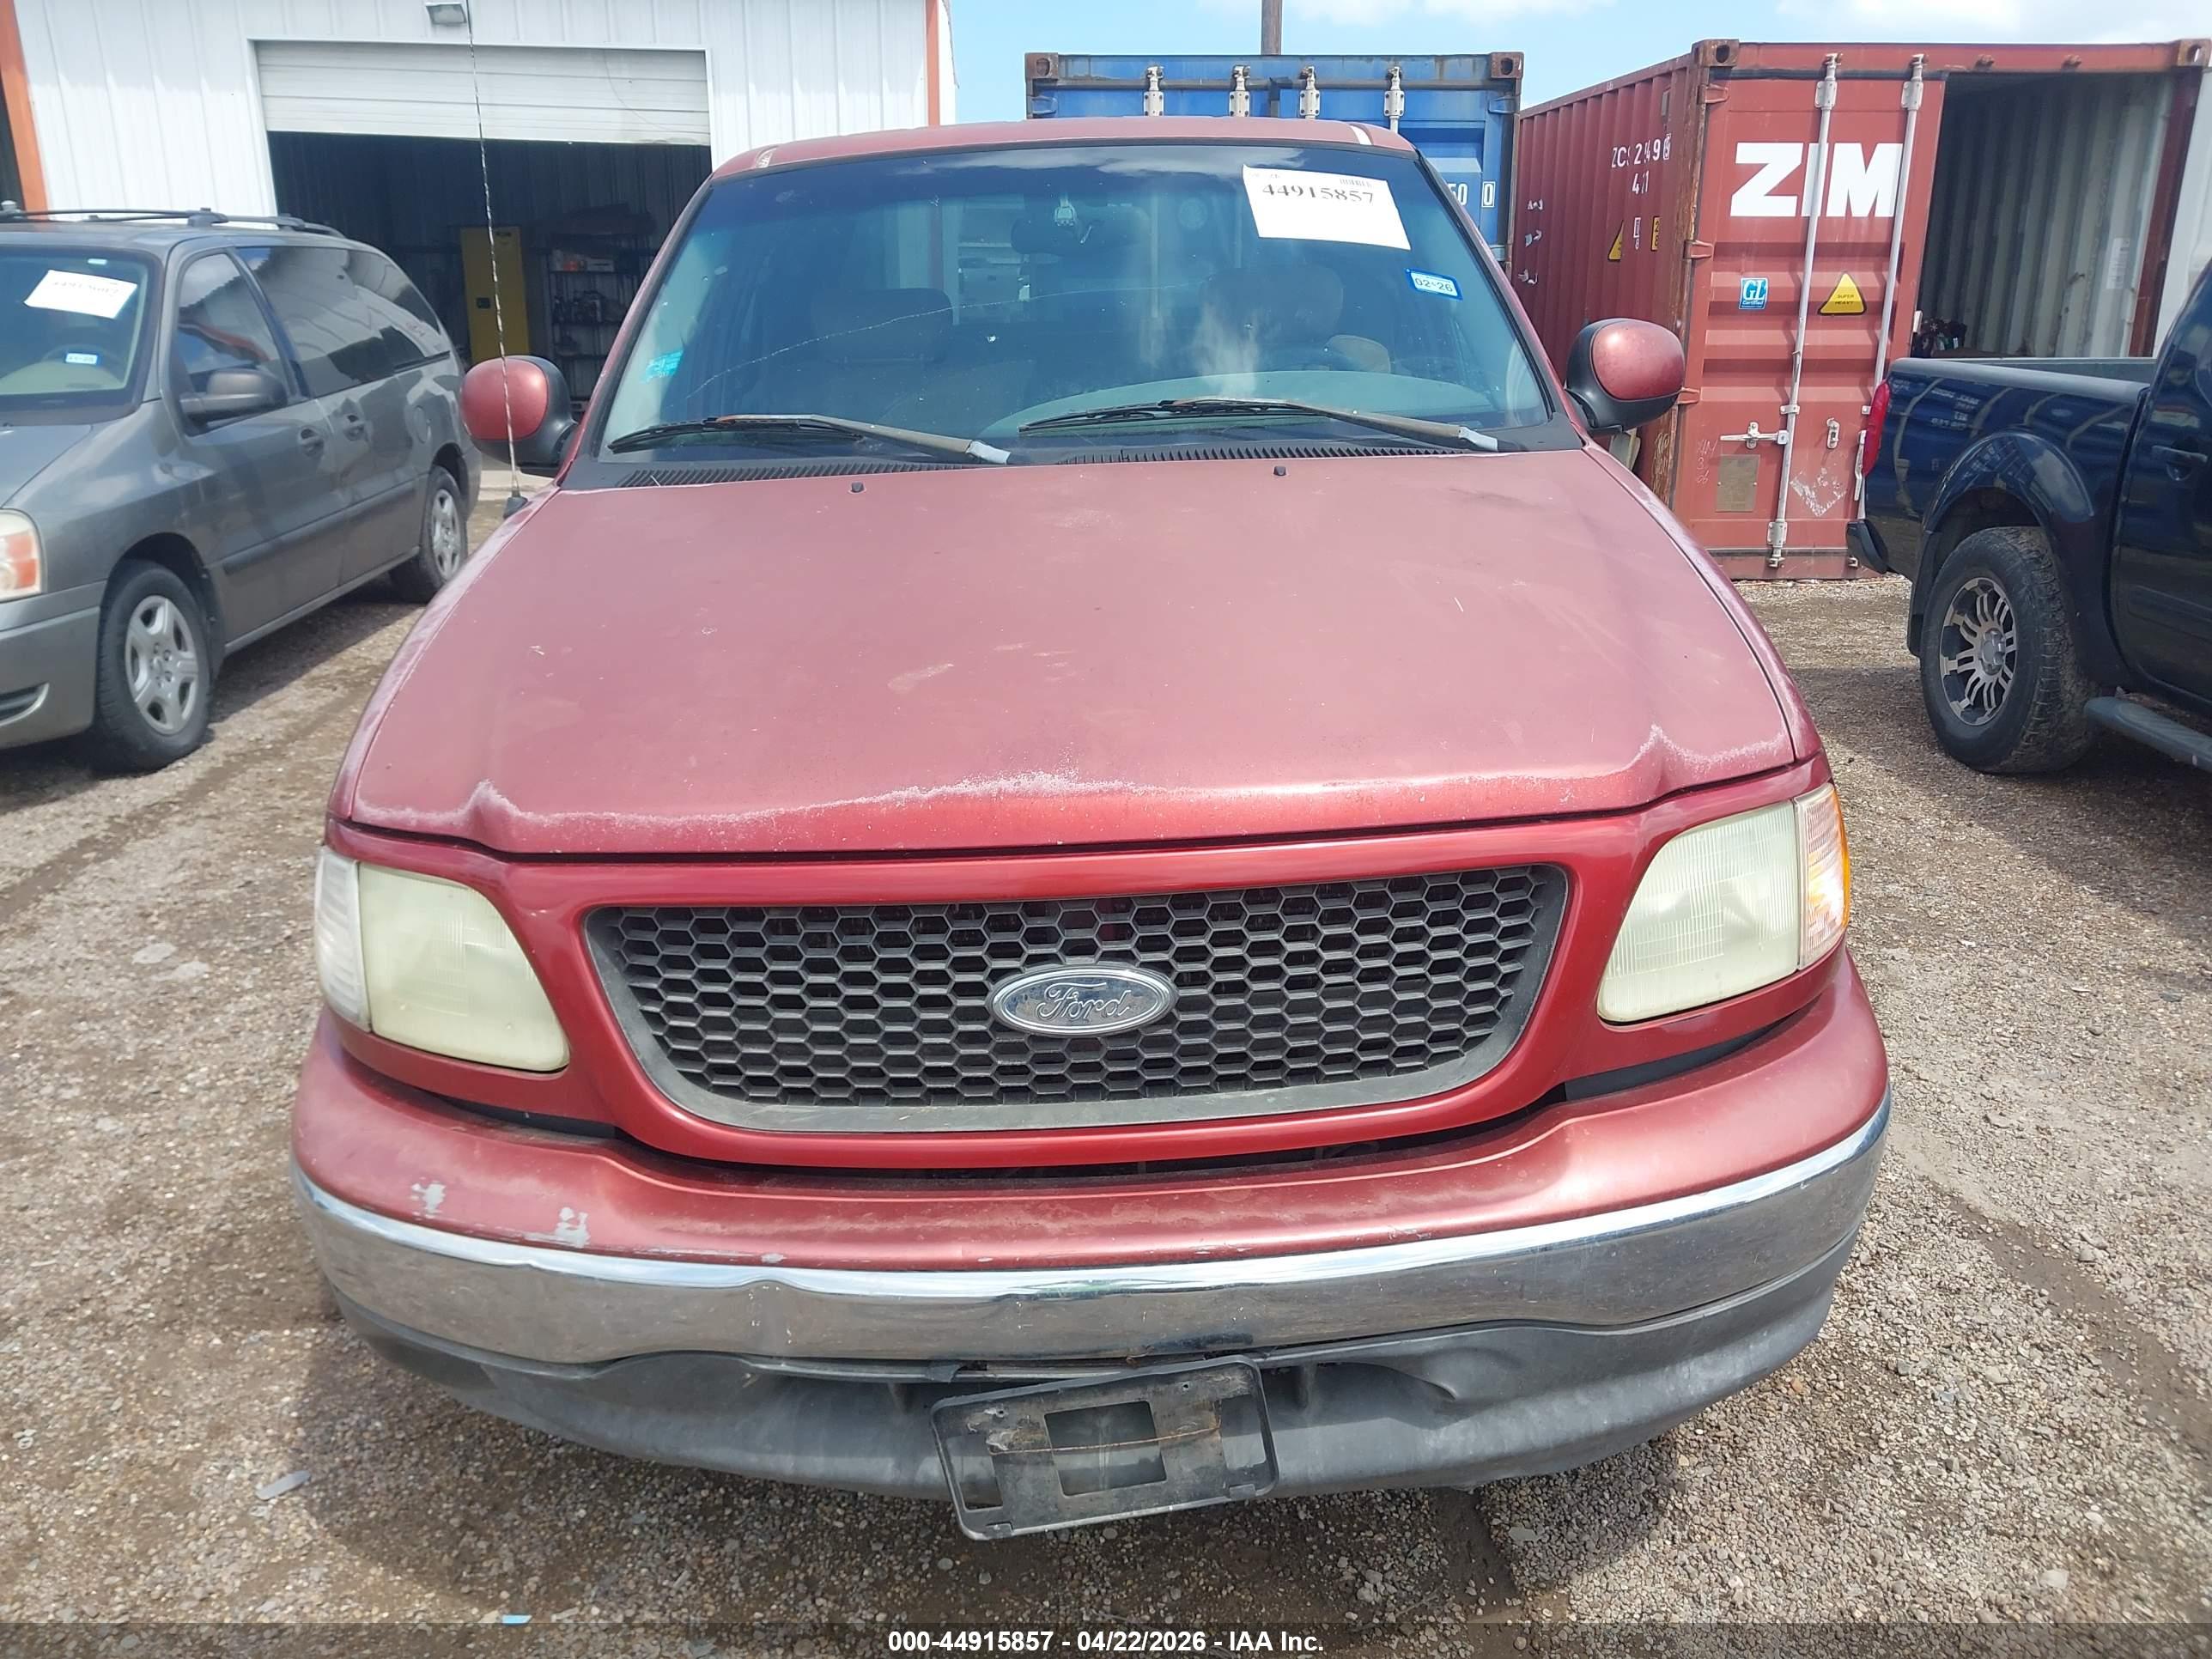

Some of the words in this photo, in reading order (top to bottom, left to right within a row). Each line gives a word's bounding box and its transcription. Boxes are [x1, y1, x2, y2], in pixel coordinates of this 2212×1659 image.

[1262, 183, 1374, 204] 44915857
[1730, 143, 1903, 217] ZIM
[1743, 279, 1766, 301] GL
[1036, 981, 1131, 1019] Ford
